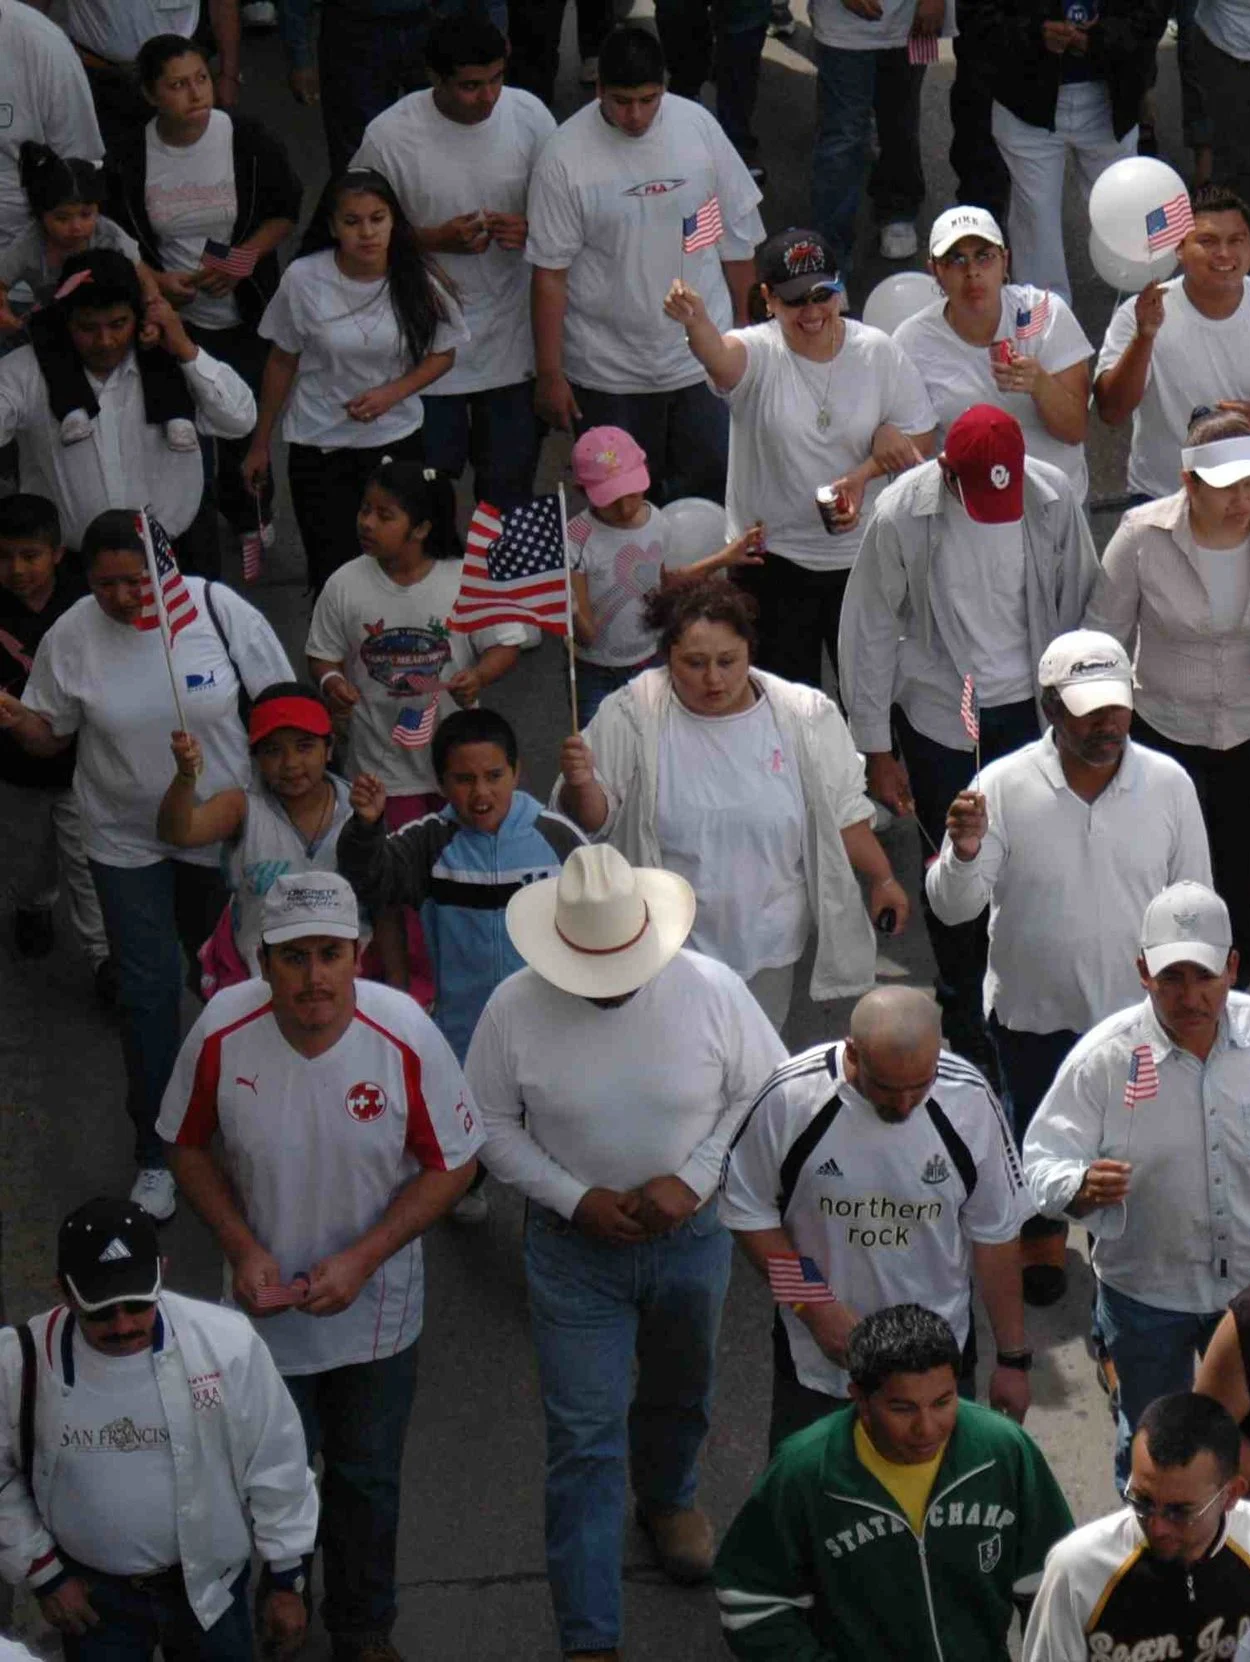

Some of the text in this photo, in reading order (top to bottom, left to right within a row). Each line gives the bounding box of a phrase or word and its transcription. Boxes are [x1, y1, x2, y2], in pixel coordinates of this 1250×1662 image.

[820, 1197, 942, 1220] northern
[848, 1226, 909, 1247] rock
[60, 1423, 170, 1448] SAN FRANCIS
[825, 1514, 906, 1559] STATE
